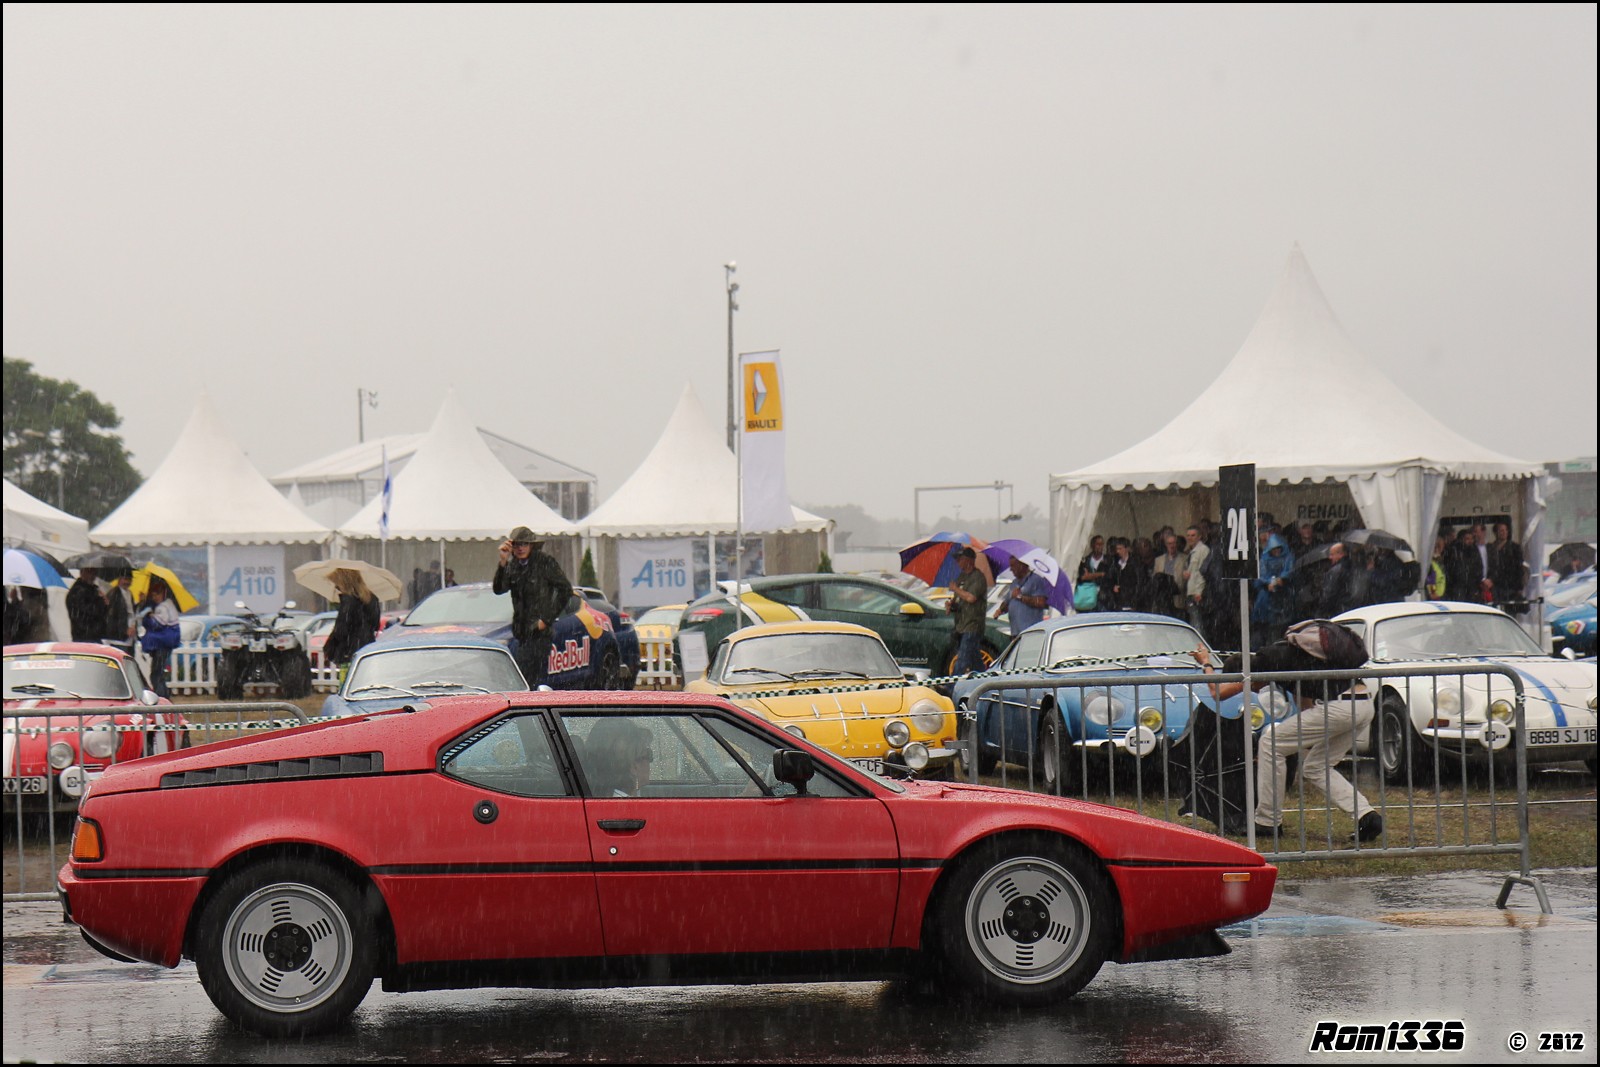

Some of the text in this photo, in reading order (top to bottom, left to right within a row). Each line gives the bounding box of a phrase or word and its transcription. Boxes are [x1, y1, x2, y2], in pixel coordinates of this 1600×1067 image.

[1227, 507, 1249, 561] 24
[656, 559, 685, 567] 50 ANS
[257, 567, 276, 575] ANS
[1530, 729, 1597, 744] 6699 SJ 18
[22, 778, 41, 792] 26
